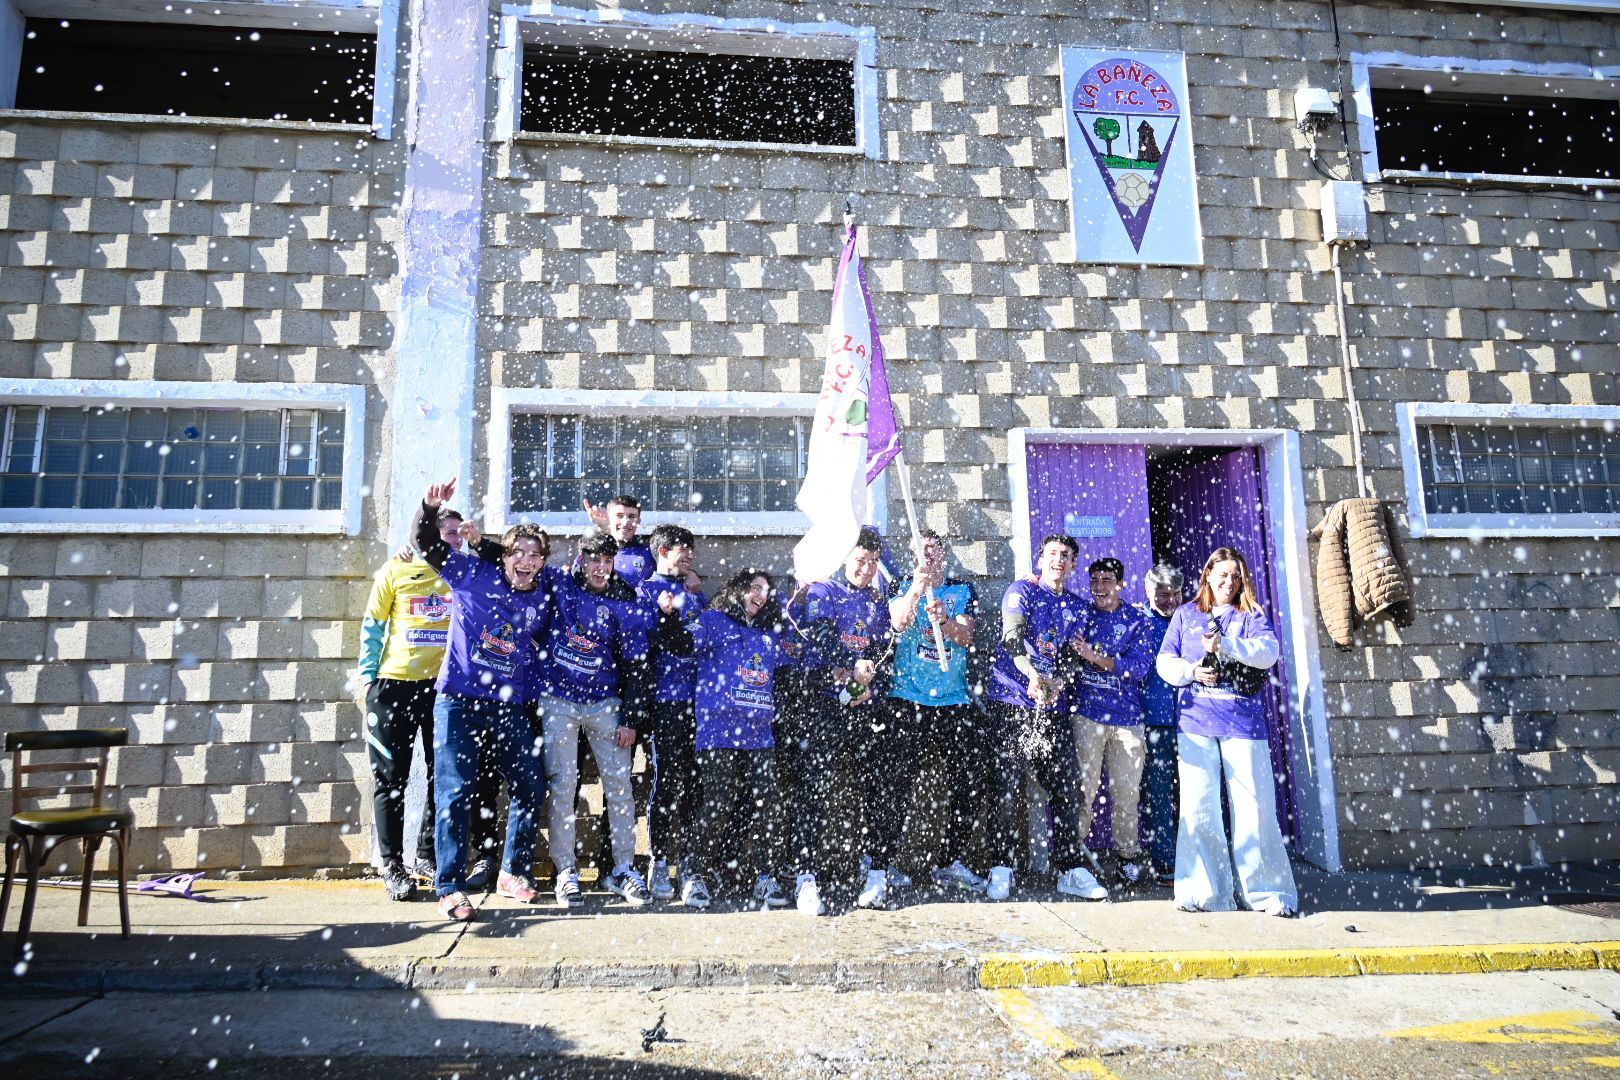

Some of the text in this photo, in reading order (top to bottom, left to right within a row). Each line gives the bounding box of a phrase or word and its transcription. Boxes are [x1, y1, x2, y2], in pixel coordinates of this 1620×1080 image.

[1078, 62, 1174, 112] LA BAÑEZA
[1115, 90, 1144, 105] F.C.
[1071, 518, 1106, 526] ENTRADA
[1067, 527, 1113, 535] VESTUARIOS
[558, 648, 598, 667] Rodrguez
[737, 664, 769, 683] luego
